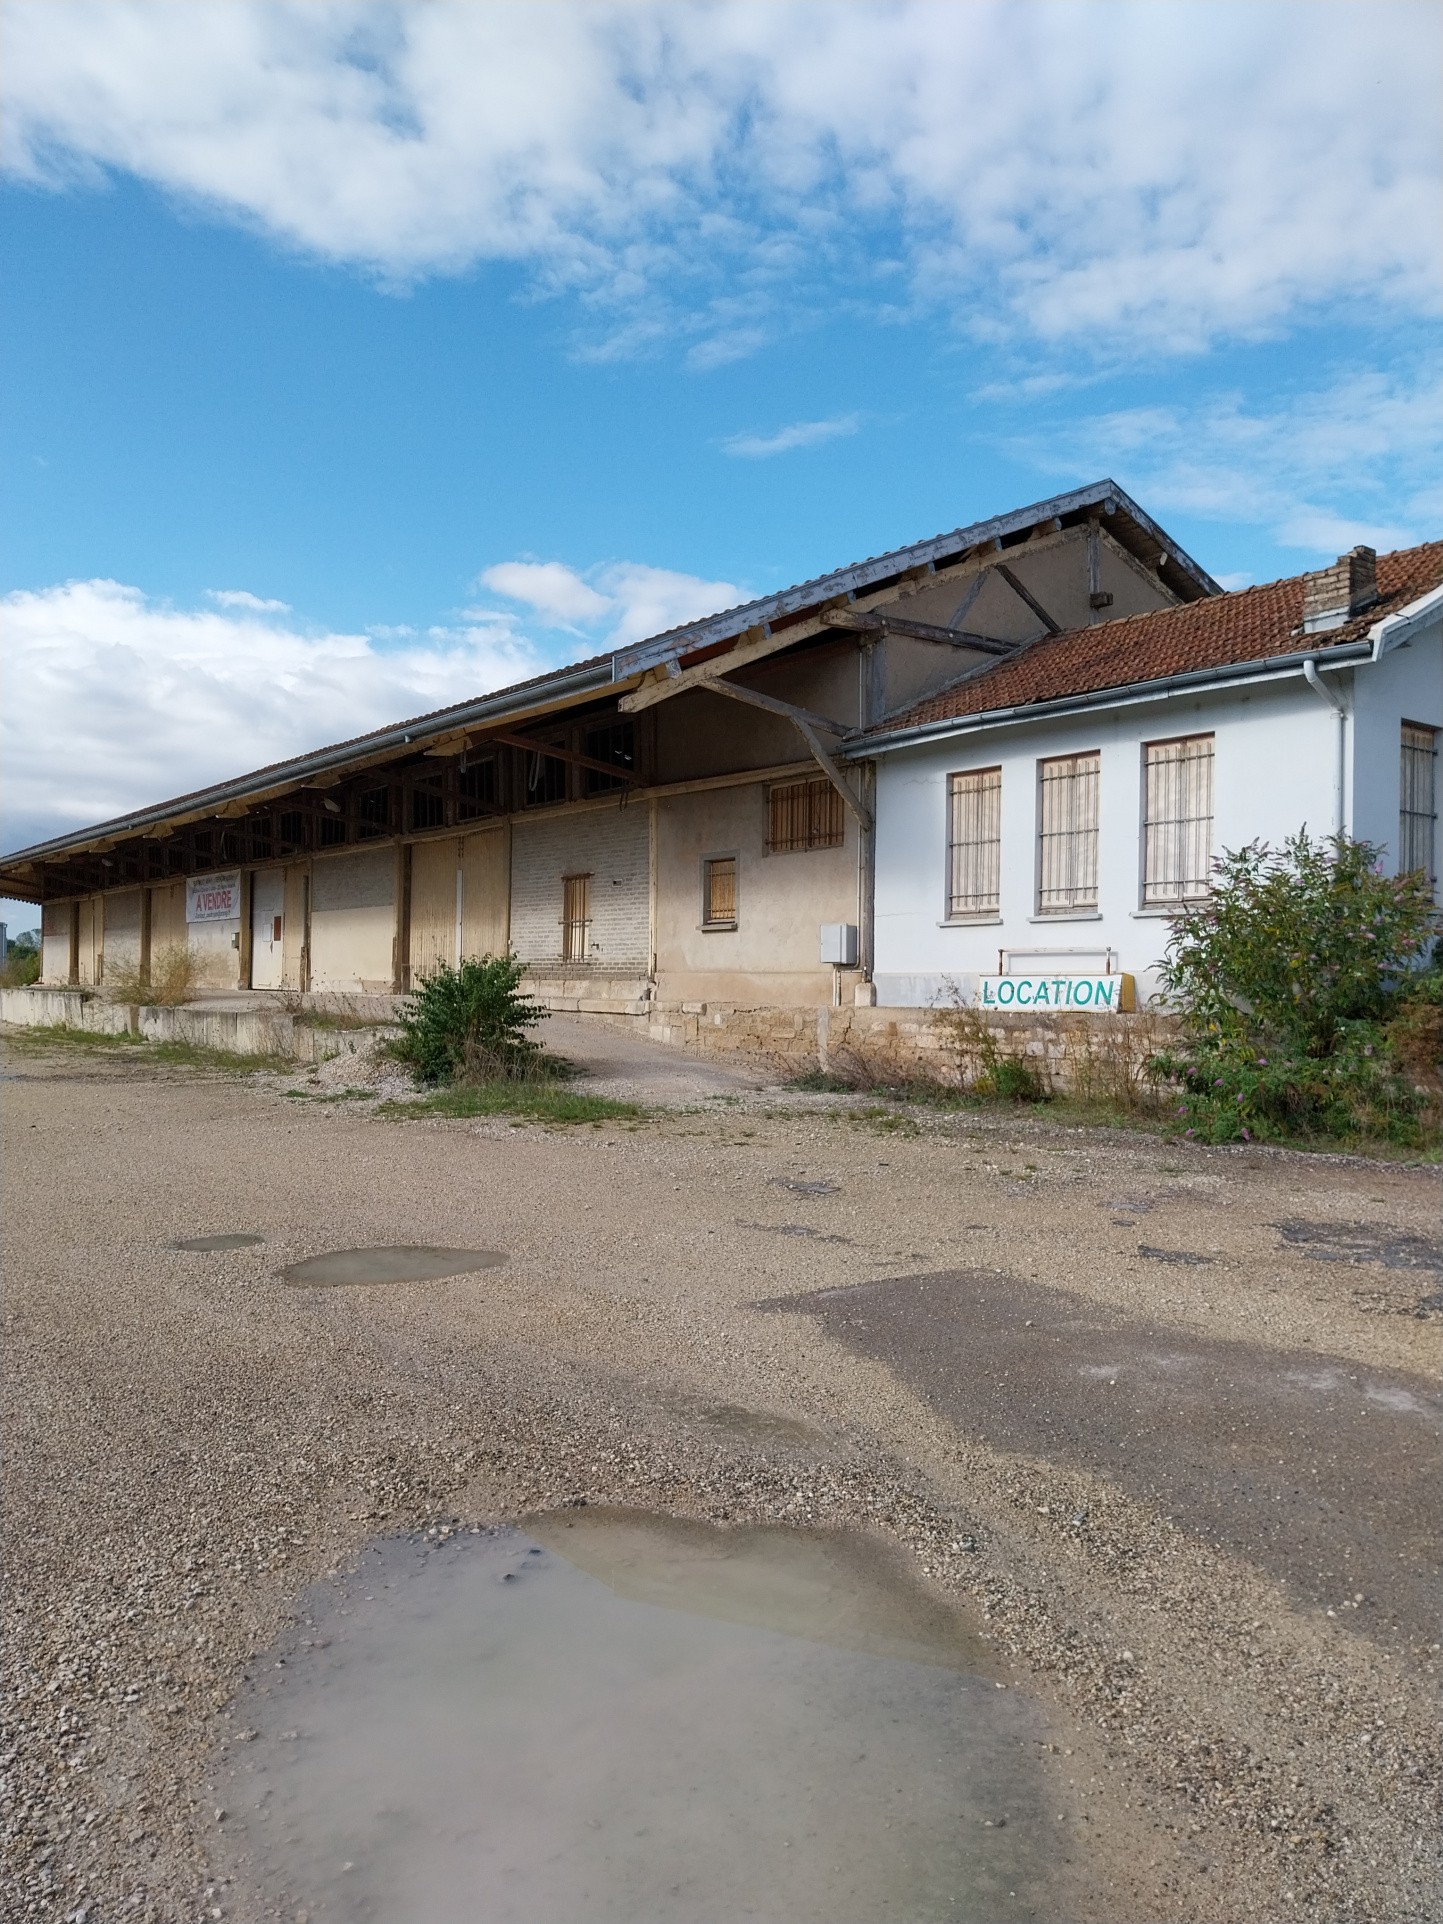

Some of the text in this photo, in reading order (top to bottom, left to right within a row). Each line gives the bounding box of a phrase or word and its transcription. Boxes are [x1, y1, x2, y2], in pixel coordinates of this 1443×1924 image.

[196, 890, 232, 912] A VENDRE
[984, 980, 1114, 1005] LOCATION
